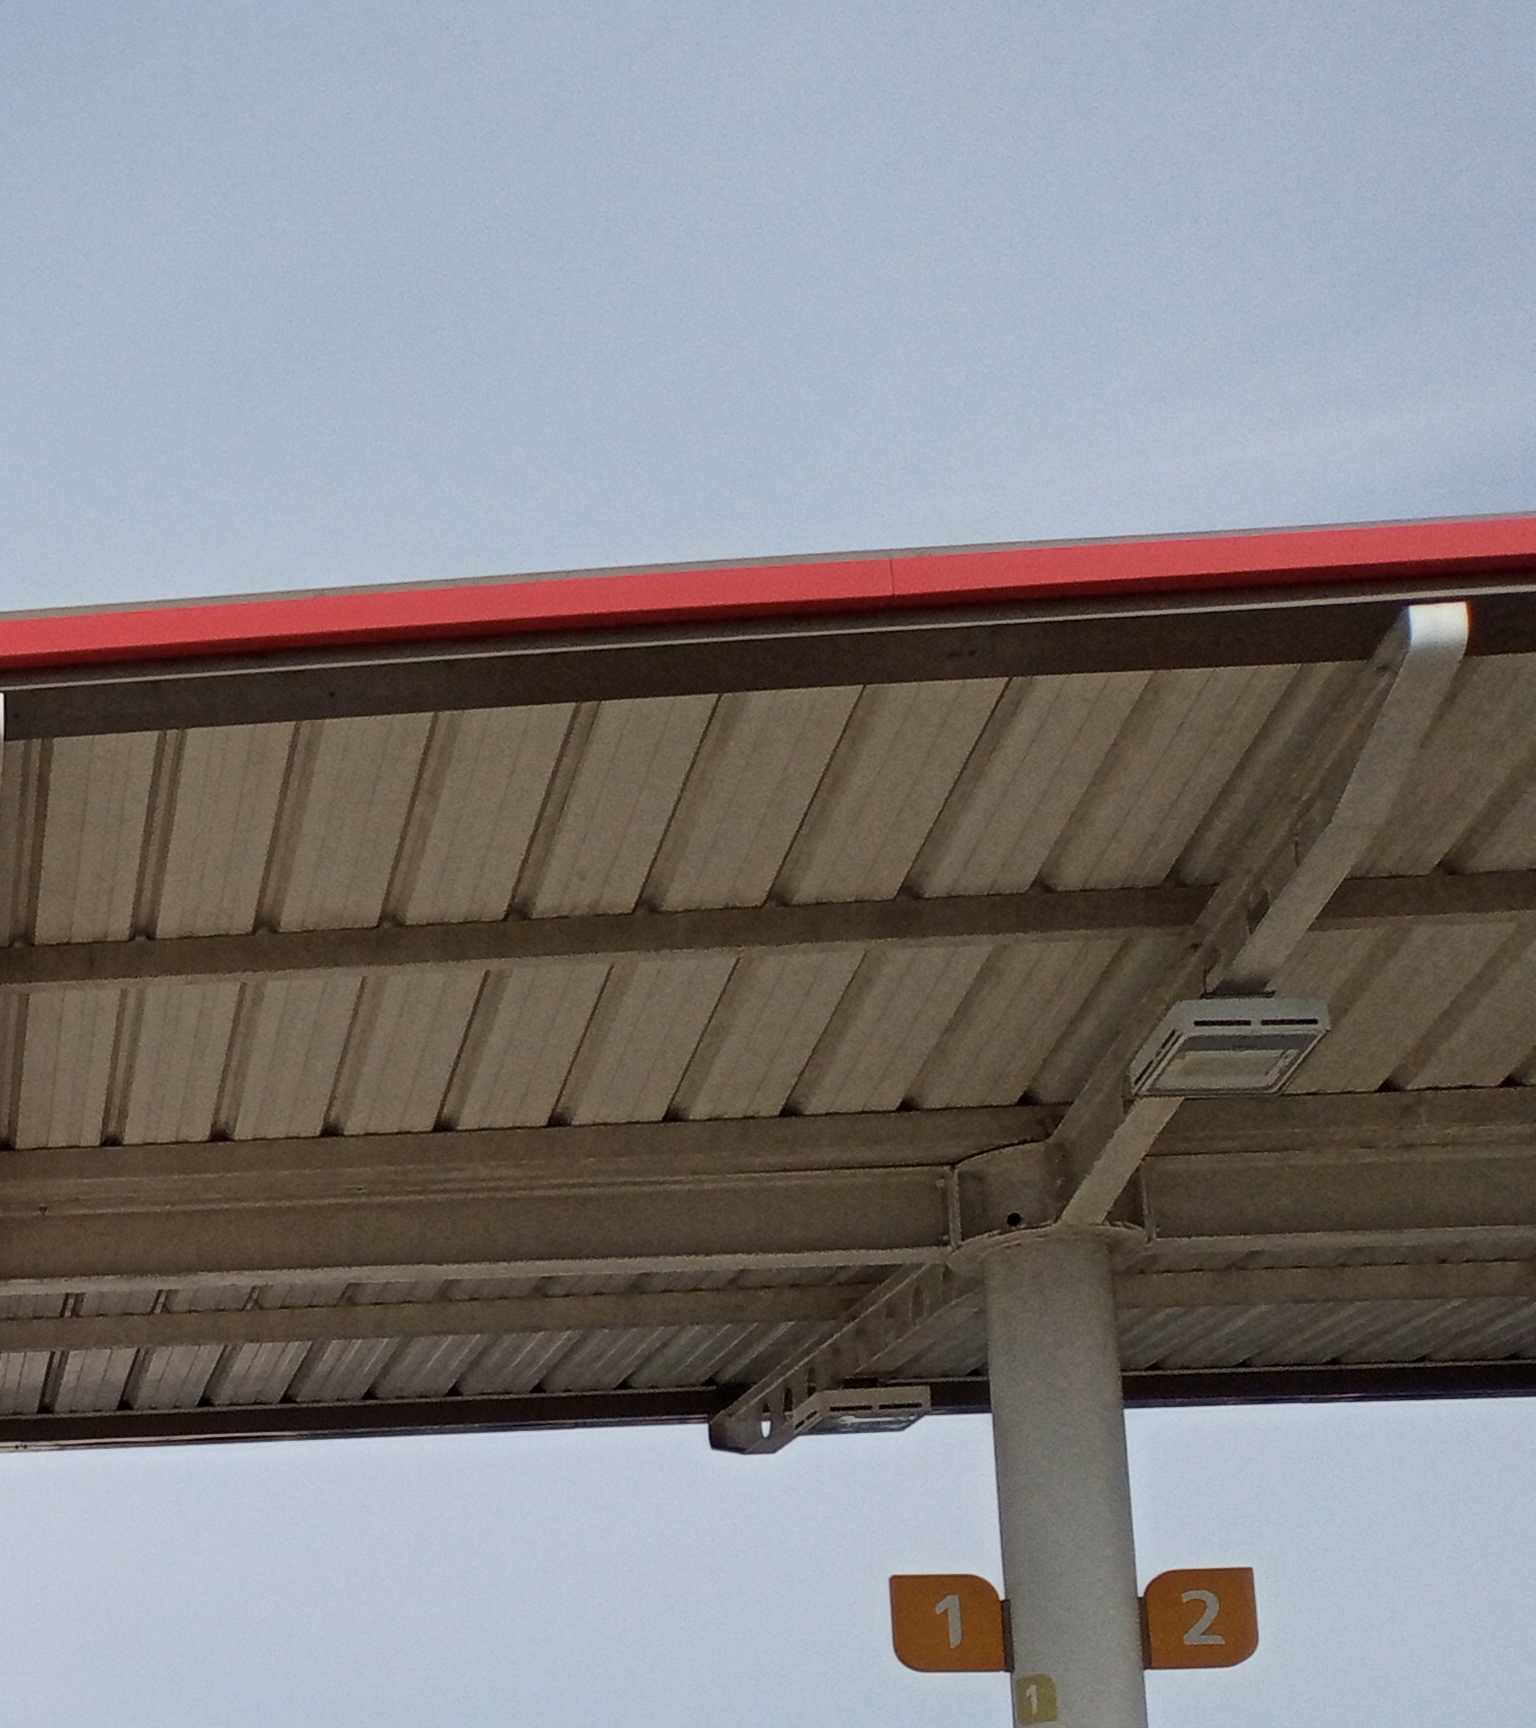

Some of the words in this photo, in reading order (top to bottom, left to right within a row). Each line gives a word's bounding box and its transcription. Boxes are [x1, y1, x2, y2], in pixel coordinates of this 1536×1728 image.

[934, 1593, 963, 1649] 1
[1180, 1588, 1226, 1646] 2
[1025, 1684, 1039, 1715] 1
